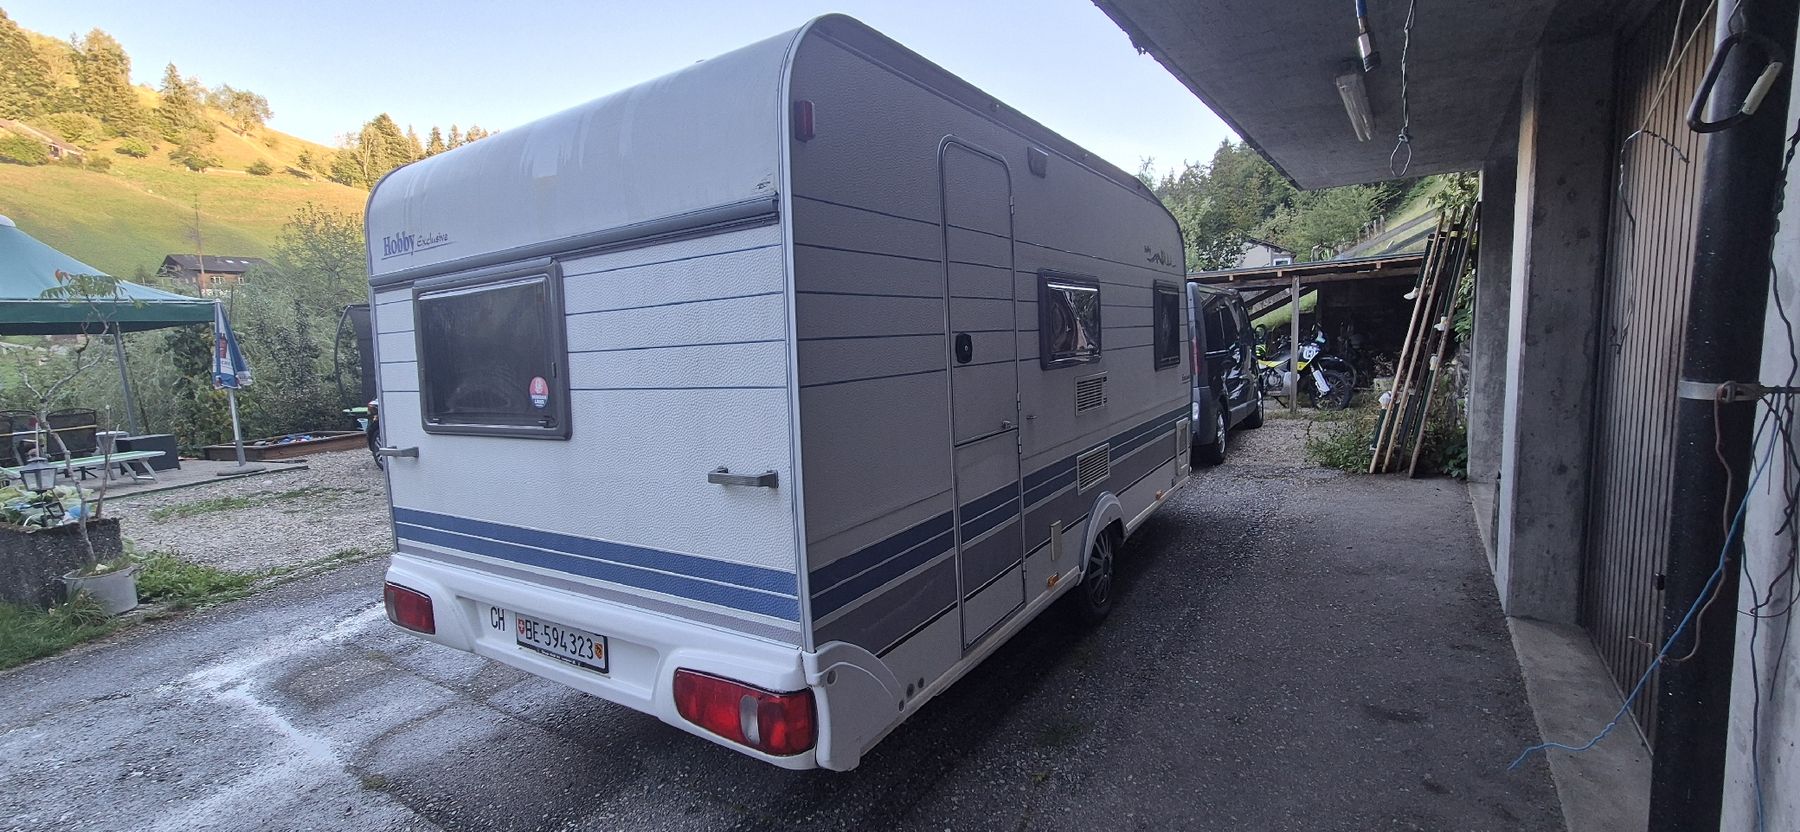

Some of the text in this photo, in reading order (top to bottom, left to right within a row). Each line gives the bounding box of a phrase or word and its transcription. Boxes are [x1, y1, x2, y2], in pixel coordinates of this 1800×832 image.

[383, 231, 449, 256] Hobby Exclusive
[490, 606, 505, 631] CH
